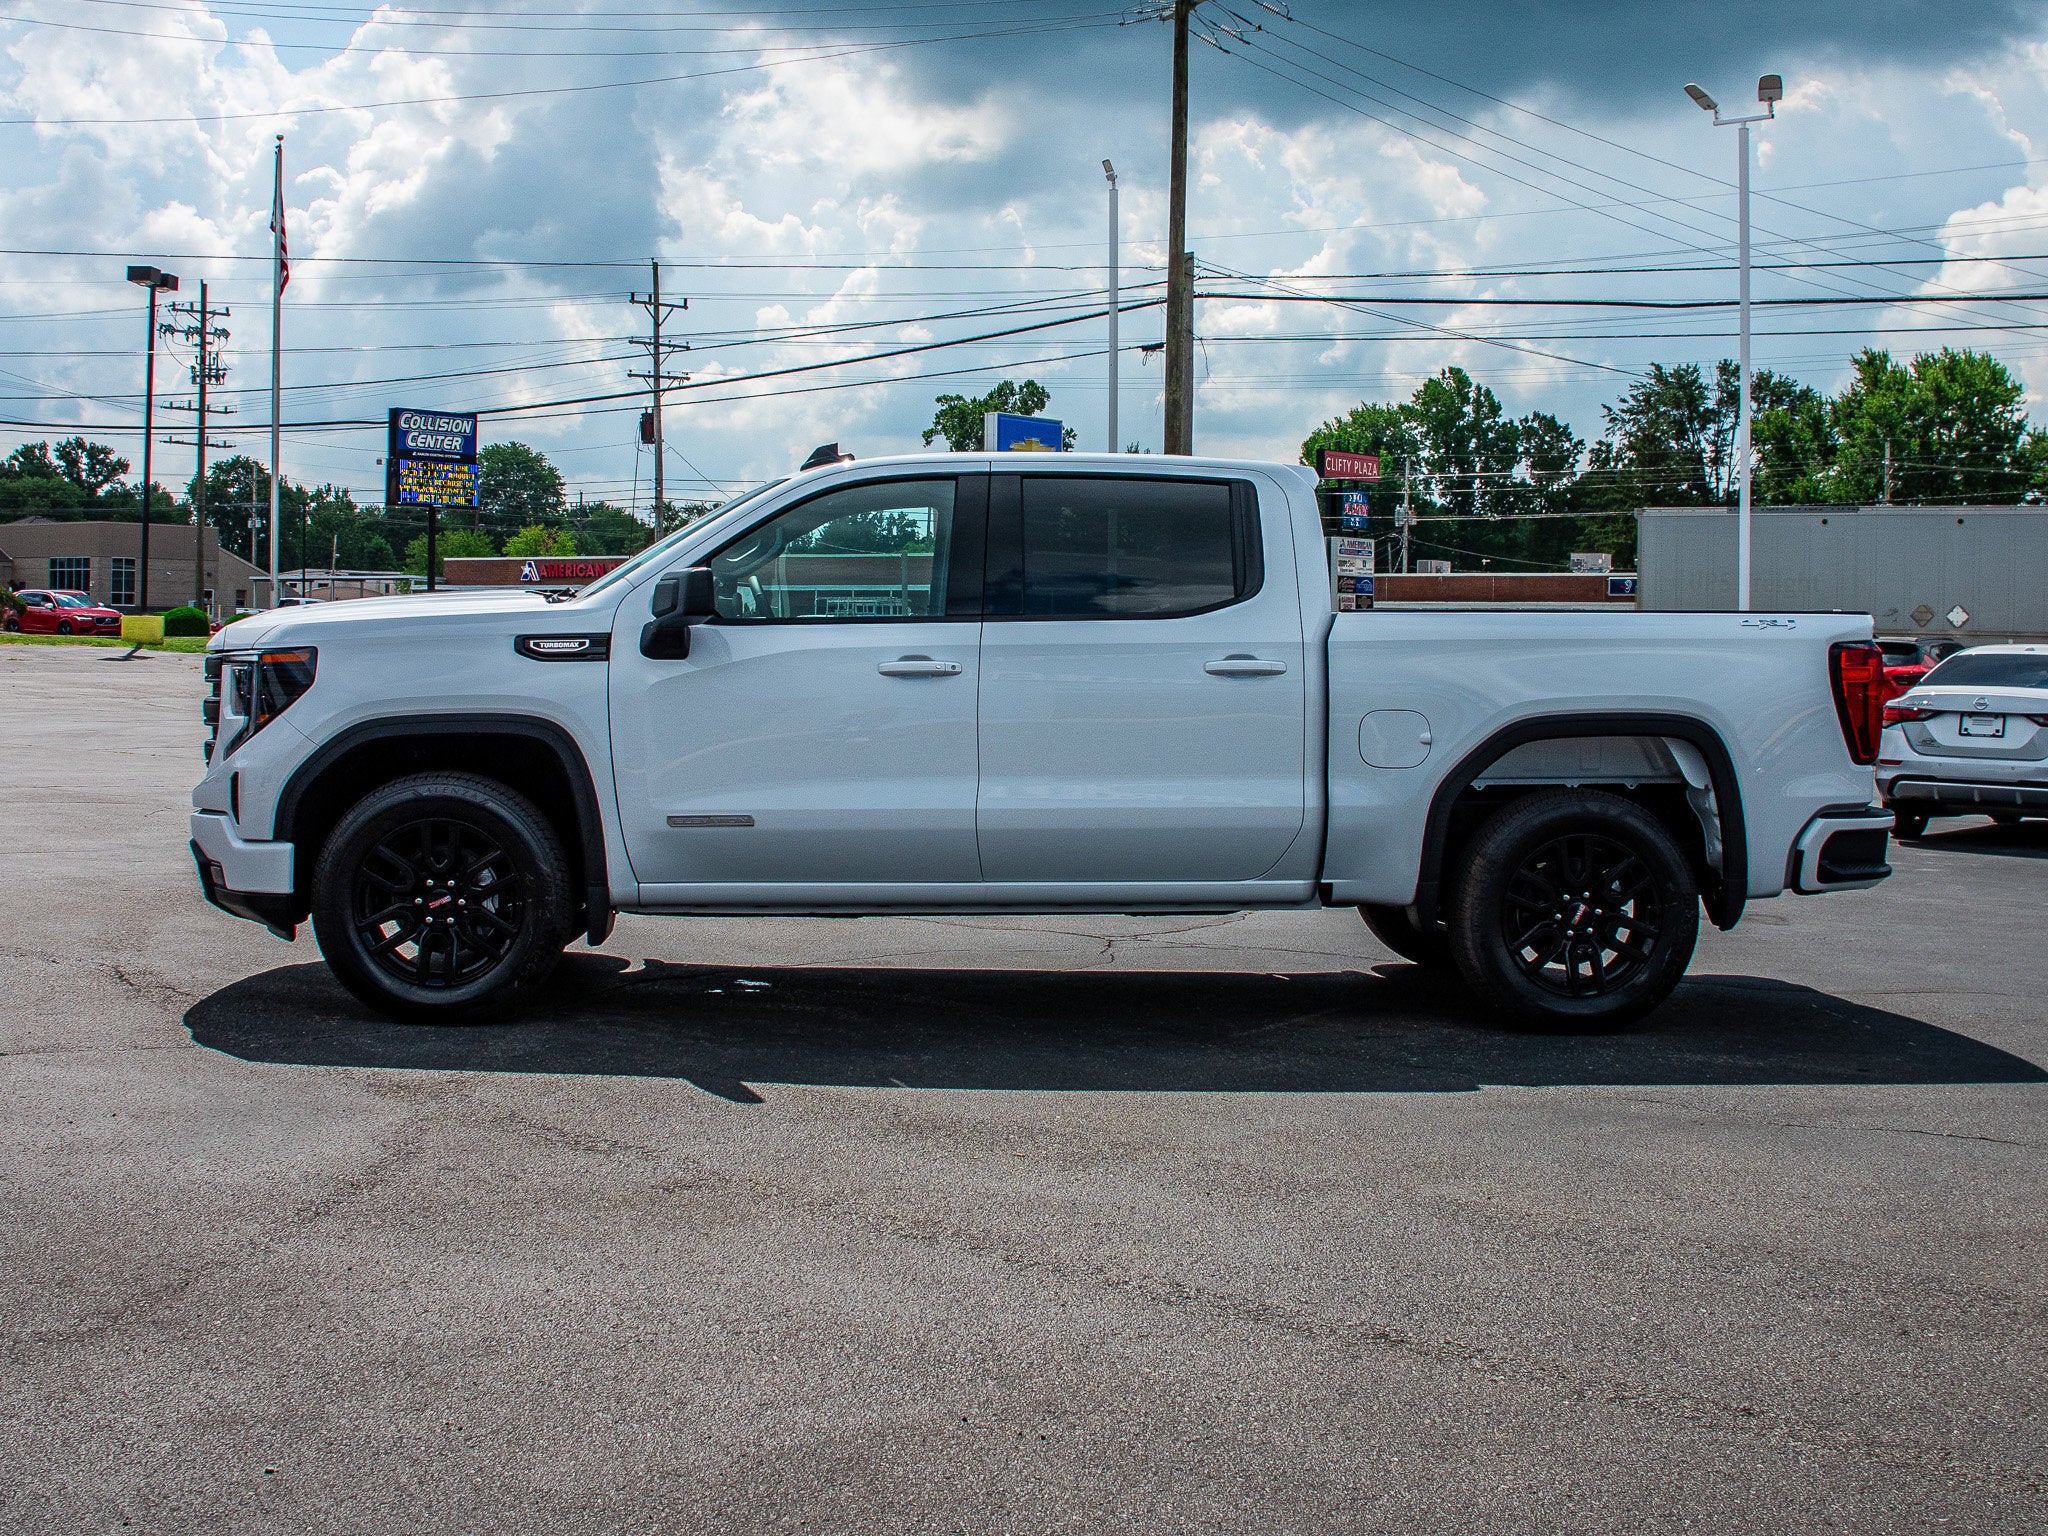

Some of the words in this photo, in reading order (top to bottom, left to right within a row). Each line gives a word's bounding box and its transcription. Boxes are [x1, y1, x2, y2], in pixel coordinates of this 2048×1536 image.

[400, 412, 473, 434] COLLISION
[407, 431, 462, 451] CENTER
[1325, 457, 1351, 473] CLIFTY
[1354, 462, 1378, 476] PLAZA
[540, 563, 604, 577] AMERICAN
